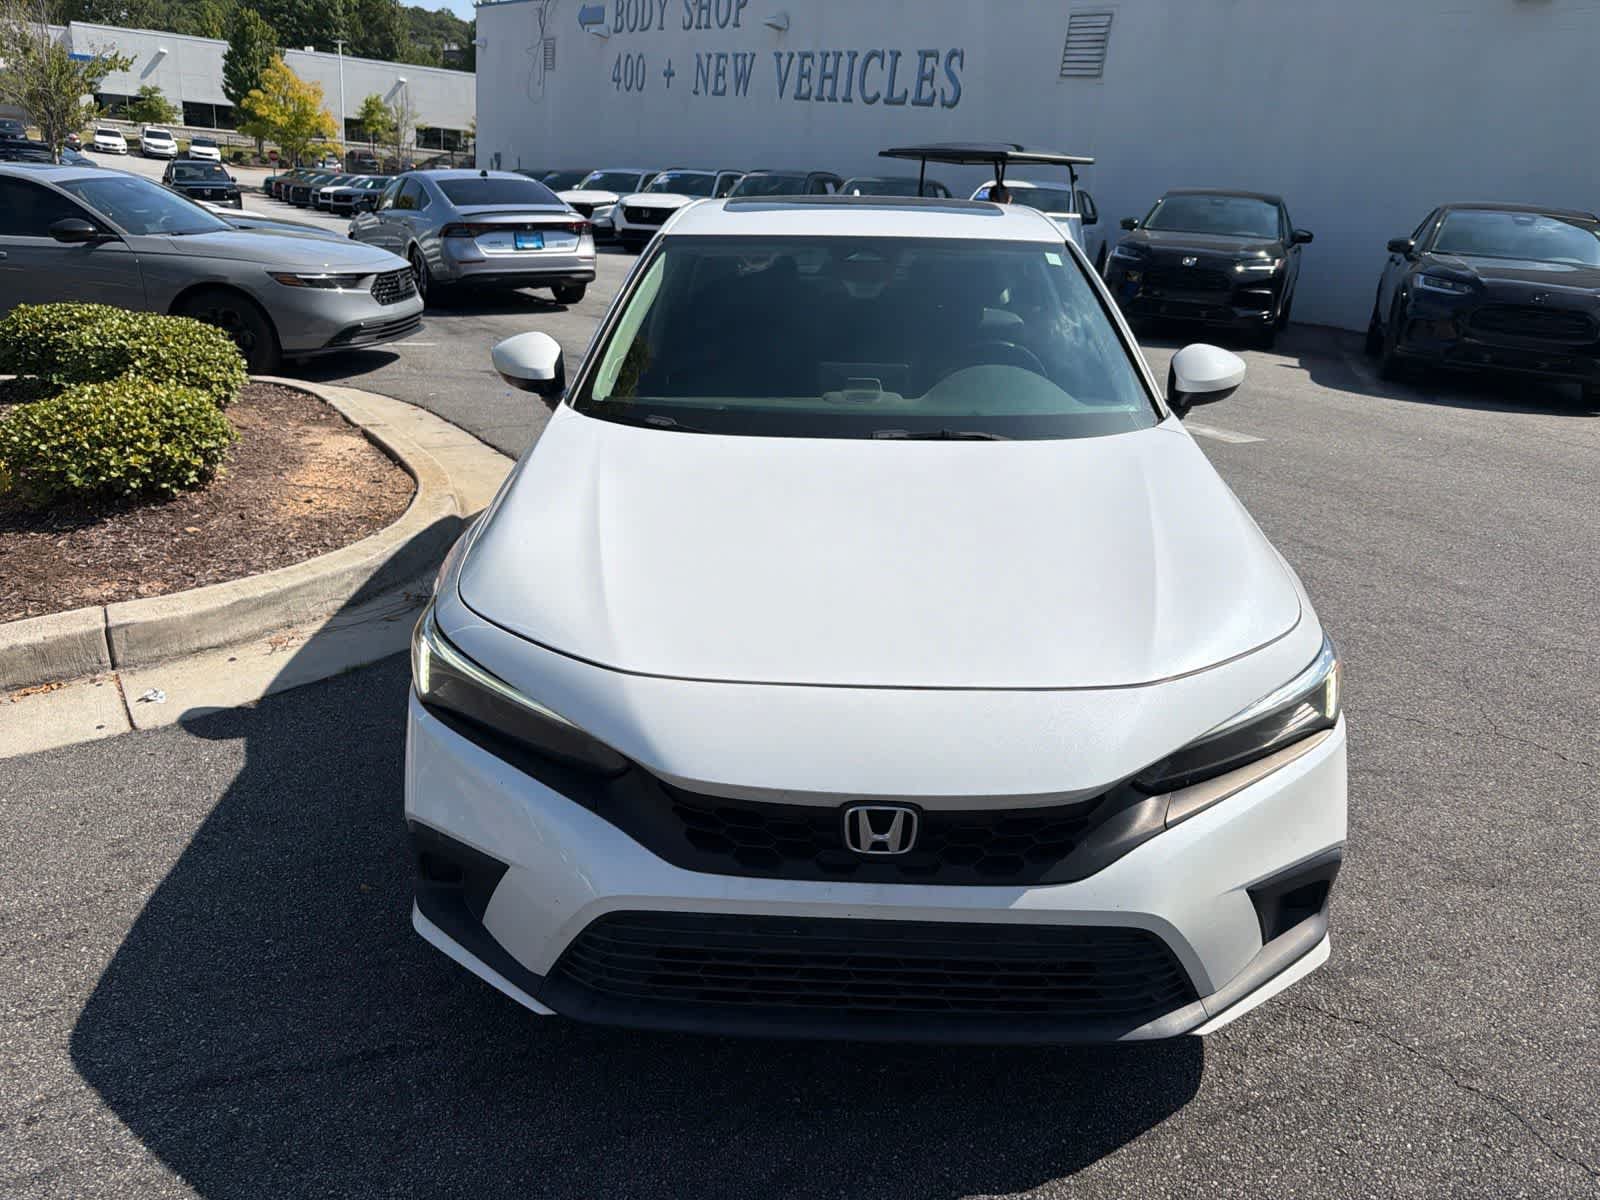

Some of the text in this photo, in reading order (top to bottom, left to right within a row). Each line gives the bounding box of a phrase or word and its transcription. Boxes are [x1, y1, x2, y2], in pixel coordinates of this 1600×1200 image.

[613, 0, 748, 33] BODY SHOP
[612, 52, 646, 92] 400
[692, 52, 756, 97] NEW
[774, 48, 965, 109] VEHICLES
